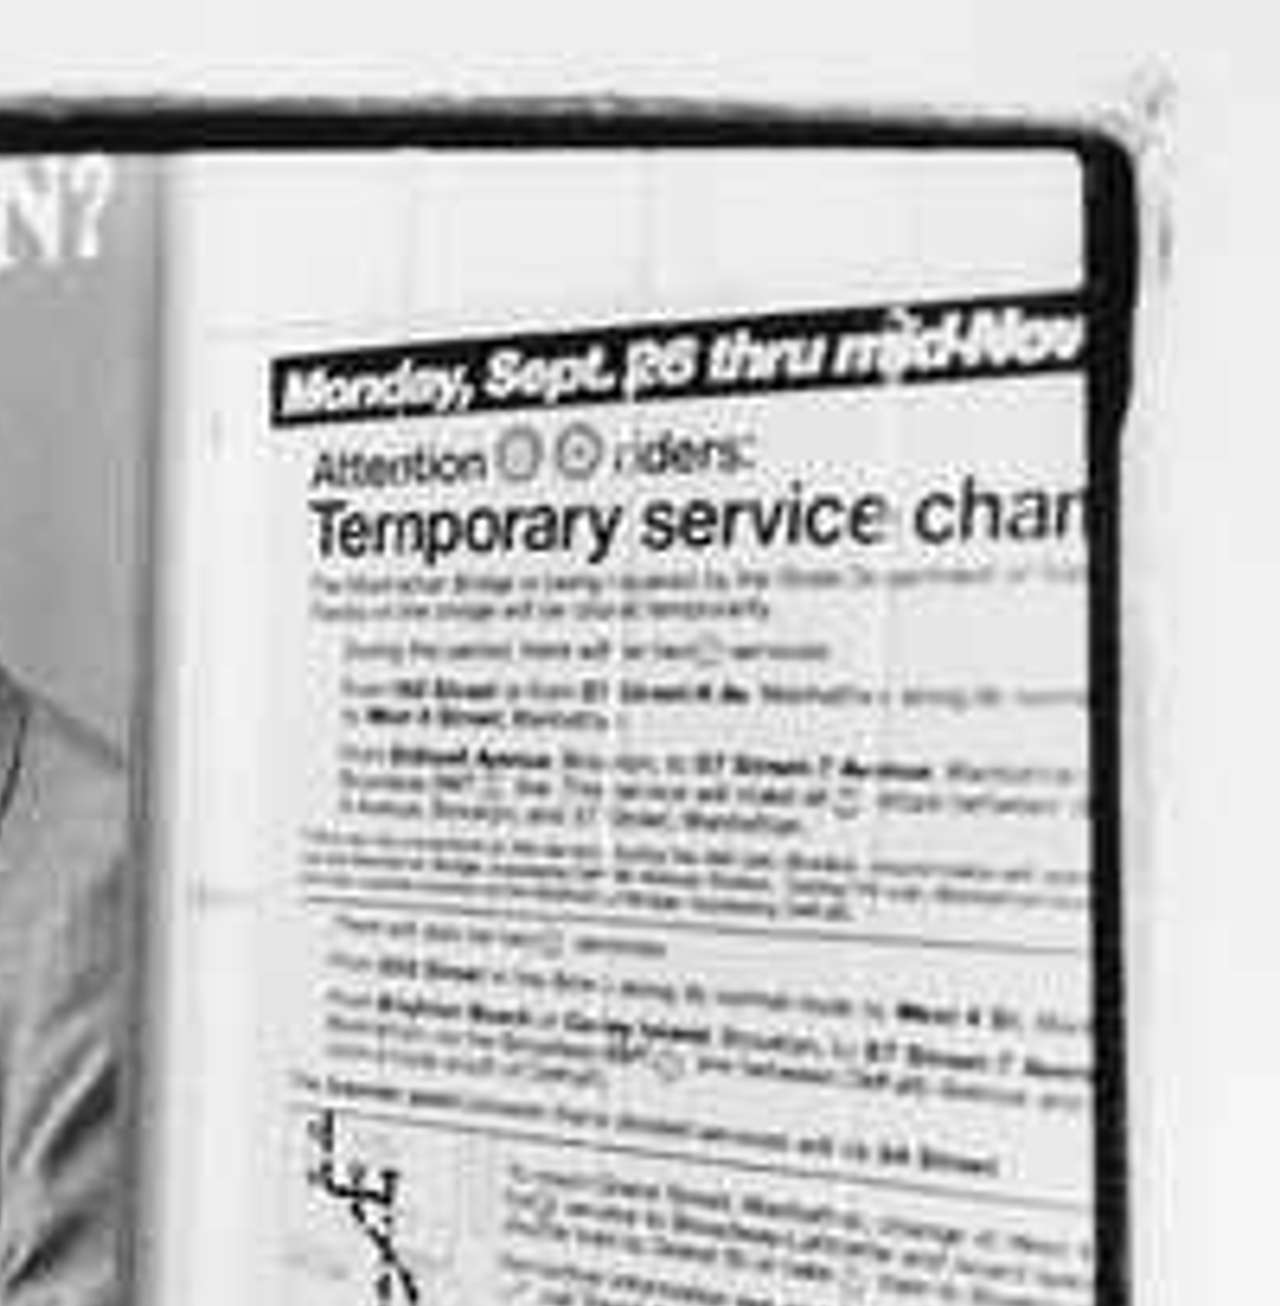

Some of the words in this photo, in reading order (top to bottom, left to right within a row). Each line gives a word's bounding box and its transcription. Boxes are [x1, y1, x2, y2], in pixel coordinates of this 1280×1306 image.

[280, 356, 476, 420] Monday,
[482, 344, 620, 404] Sept.
[708, 326, 830, 384] thru
[310, 442, 488, 490] Attention
[612, 430, 758, 480] riders:
[306, 497, 624, 566] Temporary
[640, 478, 888, 552] service
